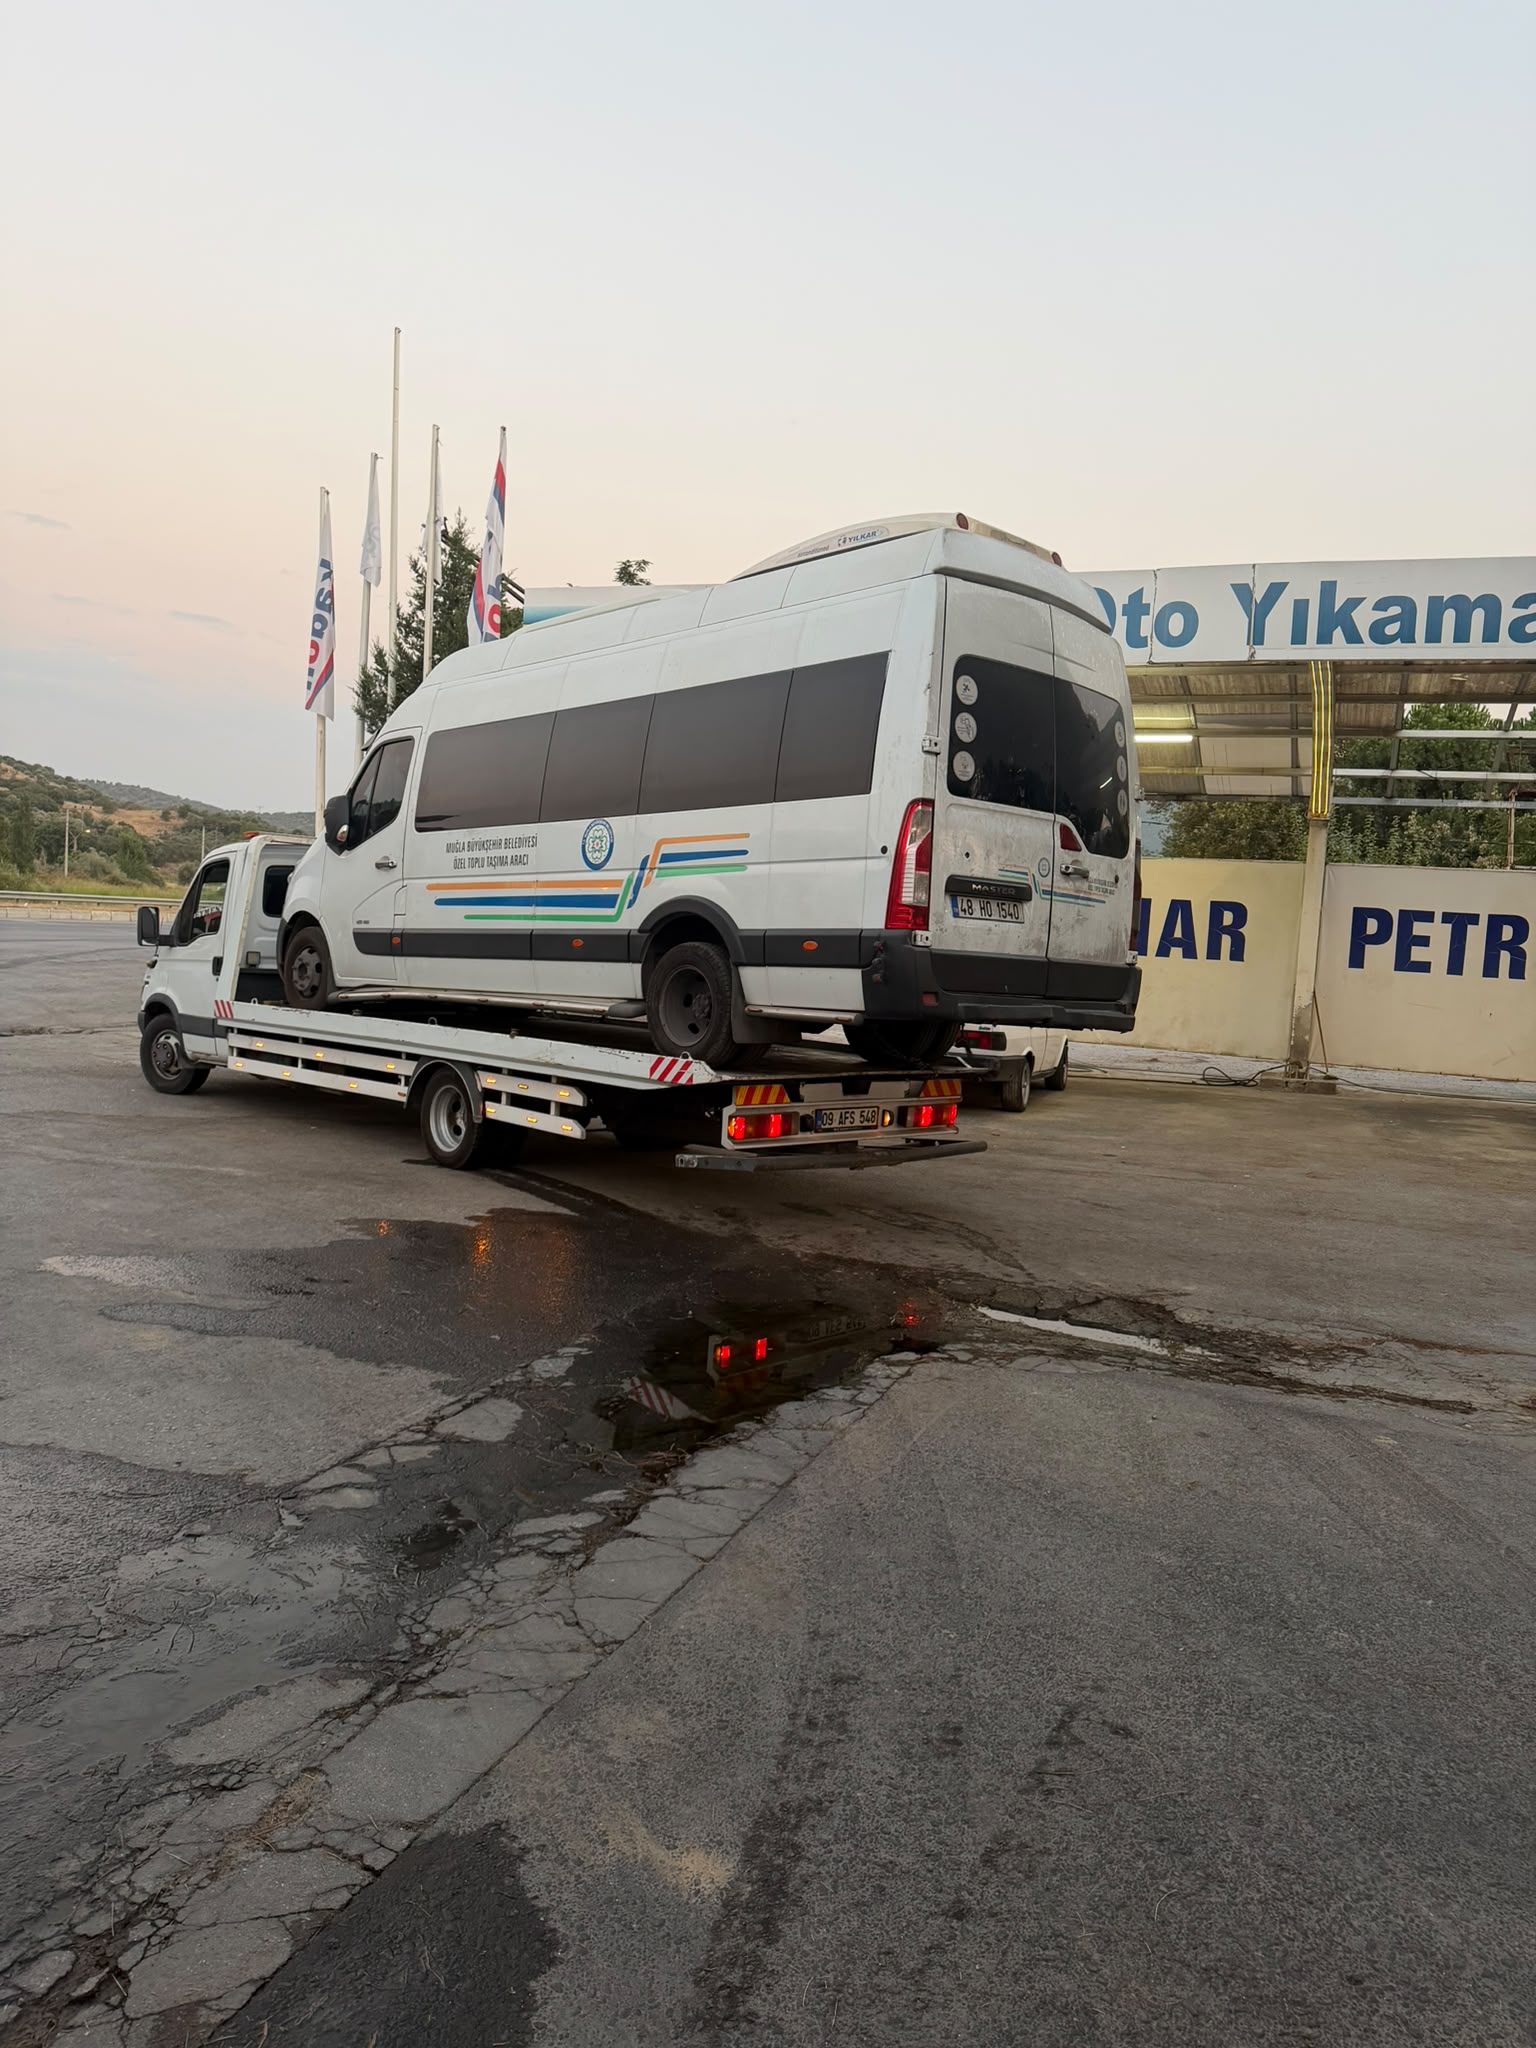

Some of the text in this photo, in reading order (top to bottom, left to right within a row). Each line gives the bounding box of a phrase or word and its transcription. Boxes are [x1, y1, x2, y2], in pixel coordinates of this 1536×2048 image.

[848, 530, 877, 543] YILKAR
[1229, 580, 1536, 646] Yıkama
[446, 833, 538, 854] MUĞLA BÜYÜKŞEHİR BELEDİYESİ
[453, 854, 529, 870] ÖZEL TOPLU TAŞIMA ARACI
[971, 883, 1016, 896] MASTER
[960, 898, 974, 916] 48
[996, 902, 1020, 920] 1540
[1348, 906, 1530, 980] PETR
[822, 1109, 876, 1126] 09 AFS 548
